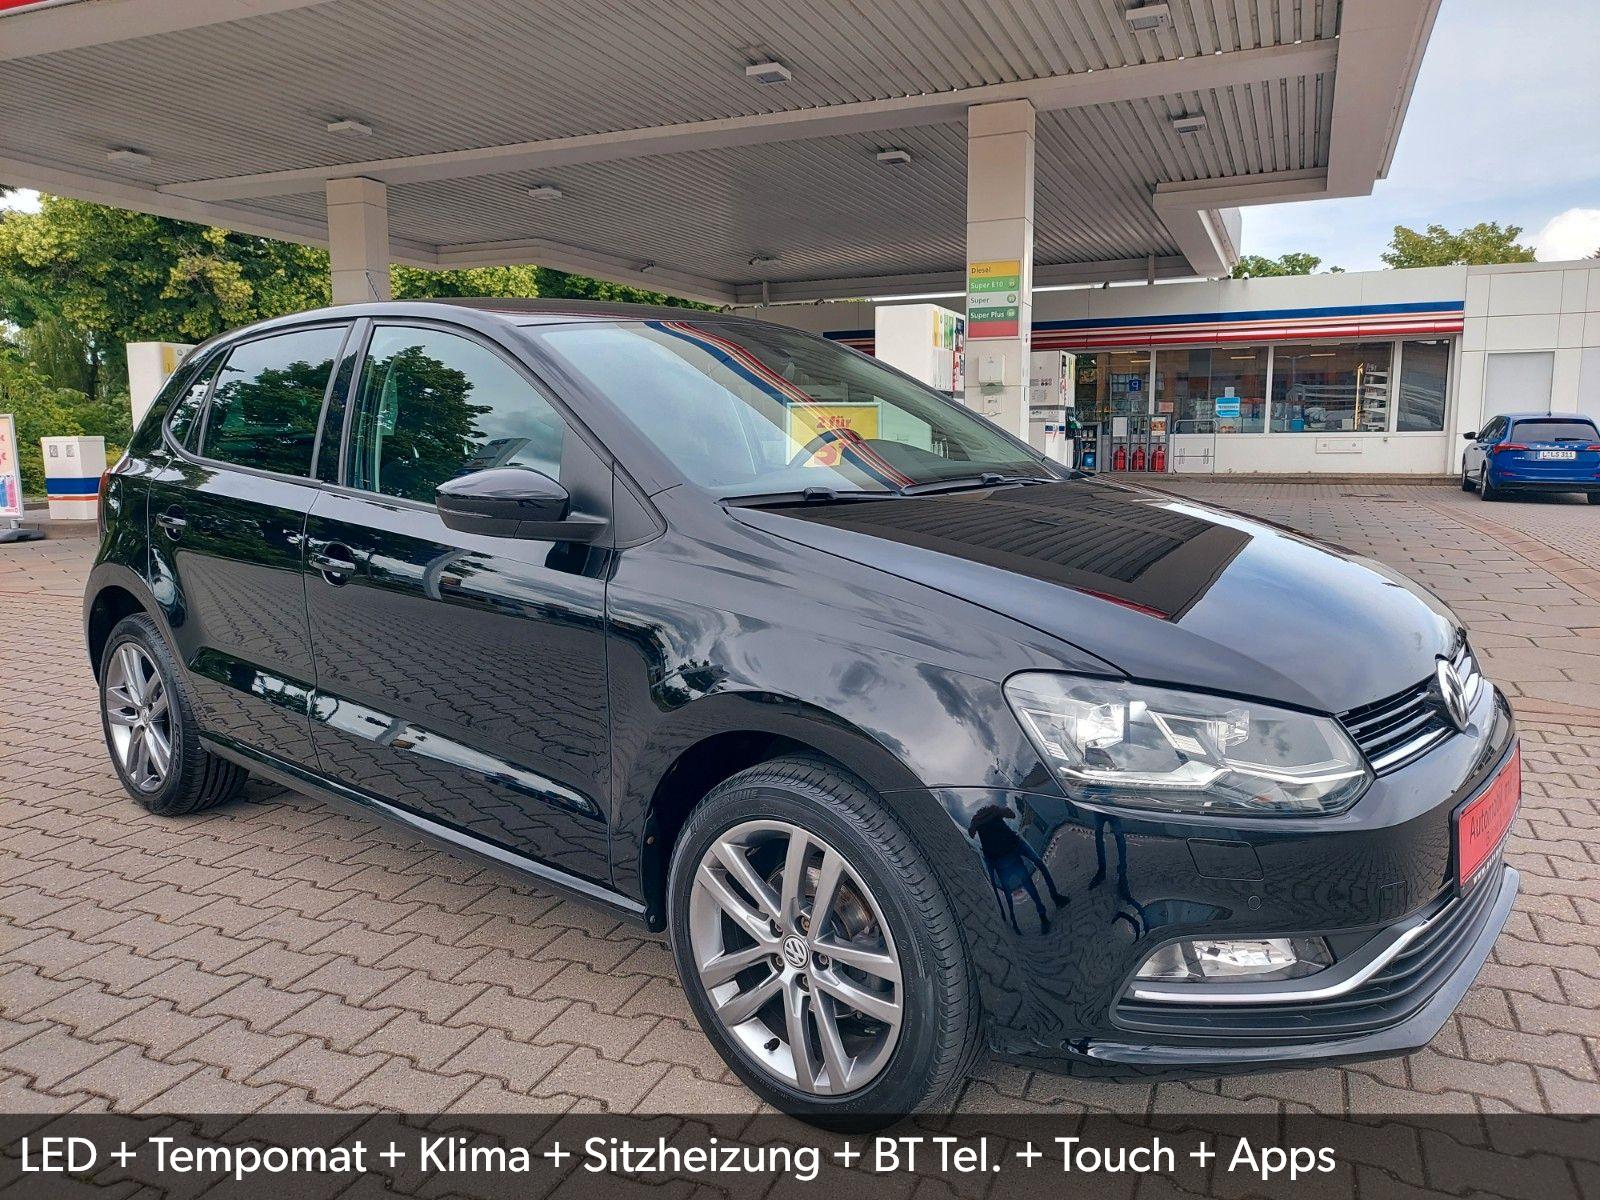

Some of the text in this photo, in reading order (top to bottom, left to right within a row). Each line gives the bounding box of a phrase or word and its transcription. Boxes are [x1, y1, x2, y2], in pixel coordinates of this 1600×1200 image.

[971, 266, 991, 274] Diesel
[970, 282, 990, 290] Super
[970, 297, 989, 305] Super
[970, 312, 990, 320] Super
